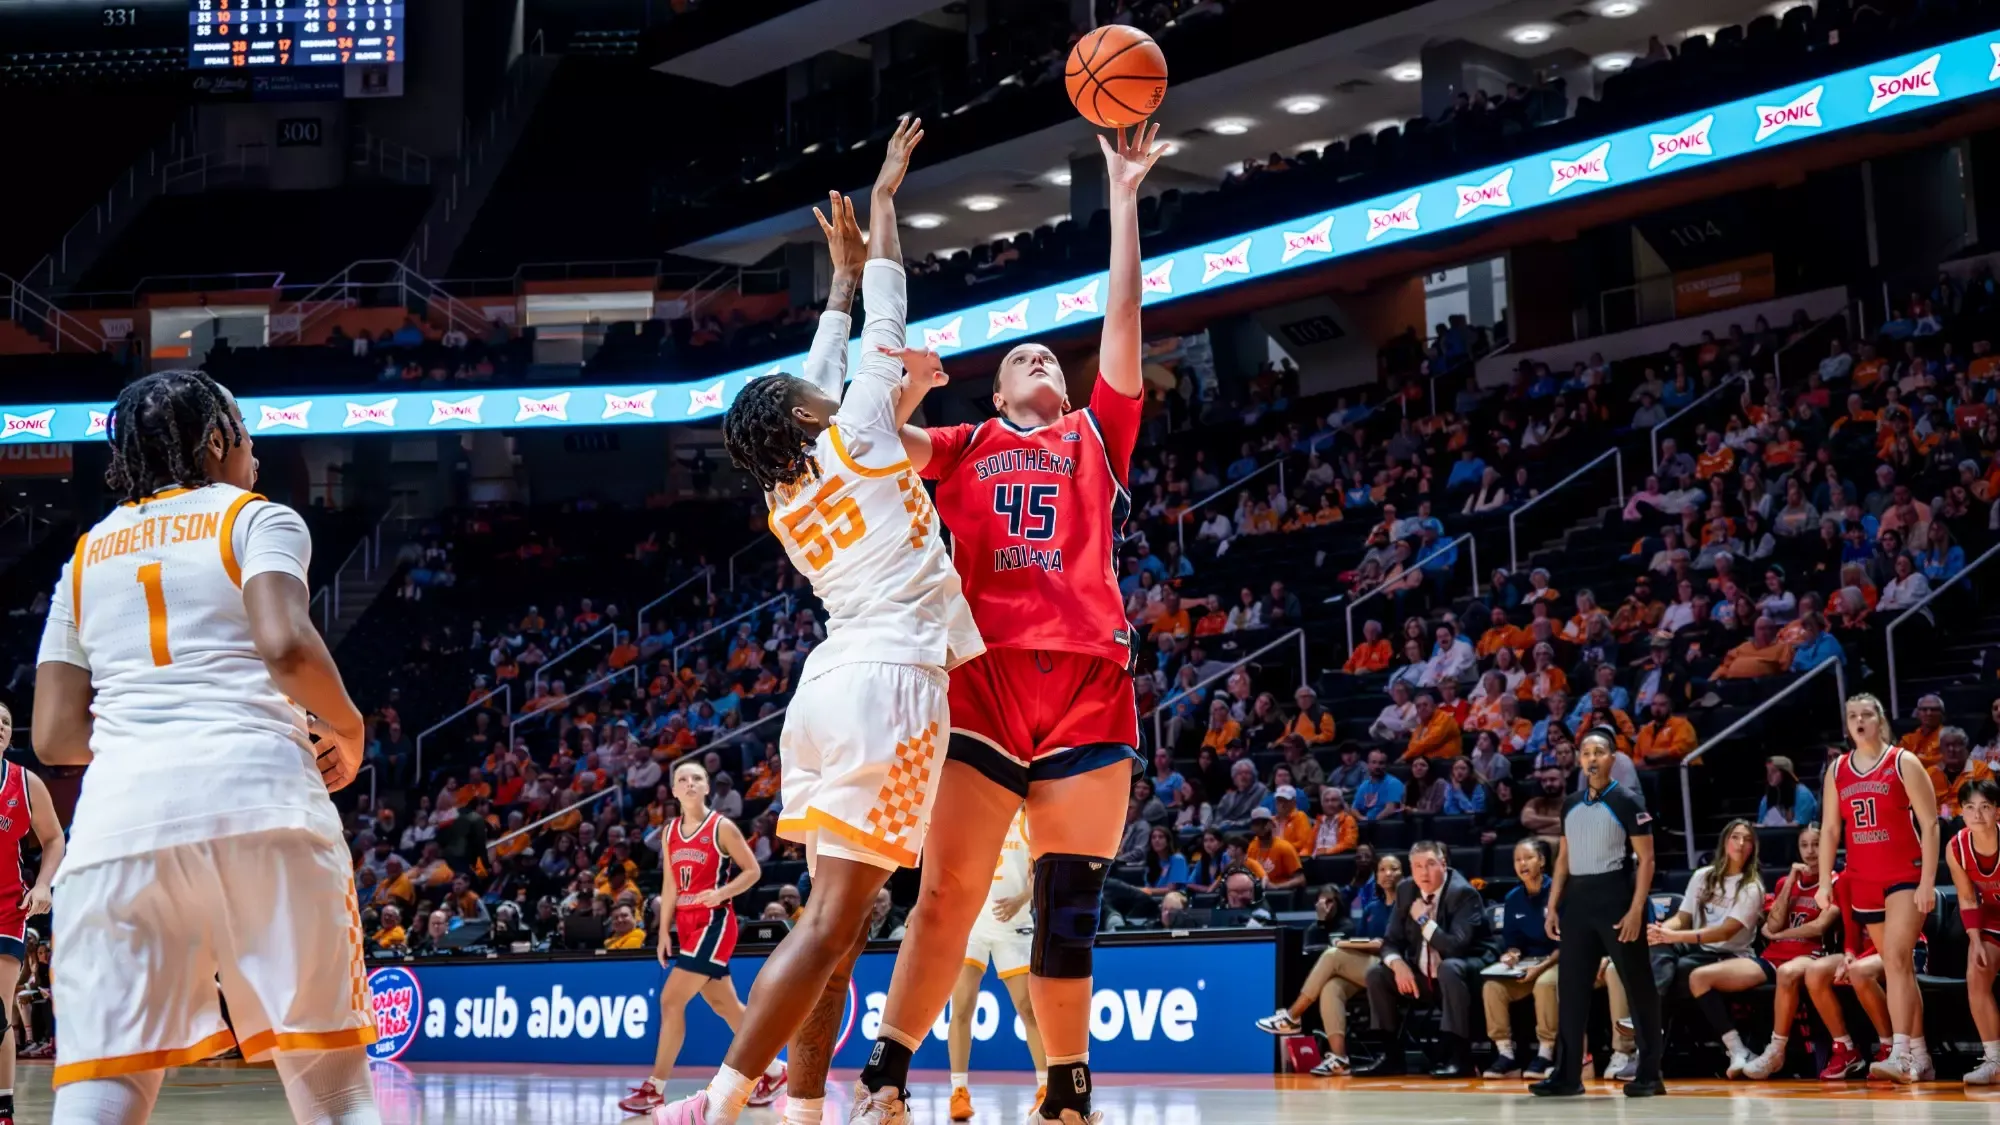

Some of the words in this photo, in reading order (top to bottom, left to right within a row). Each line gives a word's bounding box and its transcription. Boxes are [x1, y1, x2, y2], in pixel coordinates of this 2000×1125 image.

[103, 8, 136, 26] 331
[198, 12, 211, 23] 33
[217, 11, 231, 22] 10
[241, 10, 248, 22] 5
[260, 10, 267, 21] 1
[276, 9, 284, 20] 3
[304, 9, 320, 19] 44
[327, 8, 337, 19] 0
[347, 7, 356, 18] 3
[368, 6, 375, 18] 1
[385, 6, 392, 17] 1
[197, 24, 211, 36] 55
[219, 24, 228, 35] 0
[240, 23, 248, 35] 6
[259, 23, 267, 34] 3
[276, 22, 283, 34] 1
[304, 21, 320, 33] 45
[346, 20, 356, 31] 4
[366, 19, 376, 31] 0
[278, 38, 291, 51] 17
[338, 37, 353, 49] 34
[386, 35, 395, 47] 7
[232, 54, 245, 66] 15
[280, 53, 289, 65] 7
[341, 51, 350, 63] 7
[1877, 71, 1932, 99] SONIC
[1763, 102, 1814, 128] SONIC
[280, 122, 320, 143] 300
[1656, 131, 1705, 155] SONIC
[1557, 158, 1601, 182] SONIC
[1462, 183, 1505, 205] SONIC
[1373, 207, 1413, 229] SONIC
[1289, 230, 1325, 251] SONIC
[1669, 219, 1723, 248] 104
[1208, 252, 1245, 272] SONIC
[1142, 271, 1166, 288] ONIC
[1061, 295, 1092, 310] SONIC
[1288, 320, 1334, 343] 103
[351, 409, 390, 419] SONIC
[438, 406, 473, 416] SONIC
[524, 402, 560, 413] SONIC
[611, 400, 647, 410] SONIC
[7, 420, 47, 430] SONIC
[266, 411, 302, 422] SONIC
[974, 449, 1076, 480] SOUTHERN
[779, 474, 867, 571] 55
[993, 483, 1059, 541] 45
[86, 511, 220, 568] ROBERTSON
[994, 544, 1064, 572] INDIANA
[136, 561, 173, 667] 1
[1851, 796, 1877, 828] 21
[370, 986, 412, 1013] ersey
[424, 997, 446, 1039] a
[454, 985, 519, 1039] sub
[526, 984, 649, 1040] above
